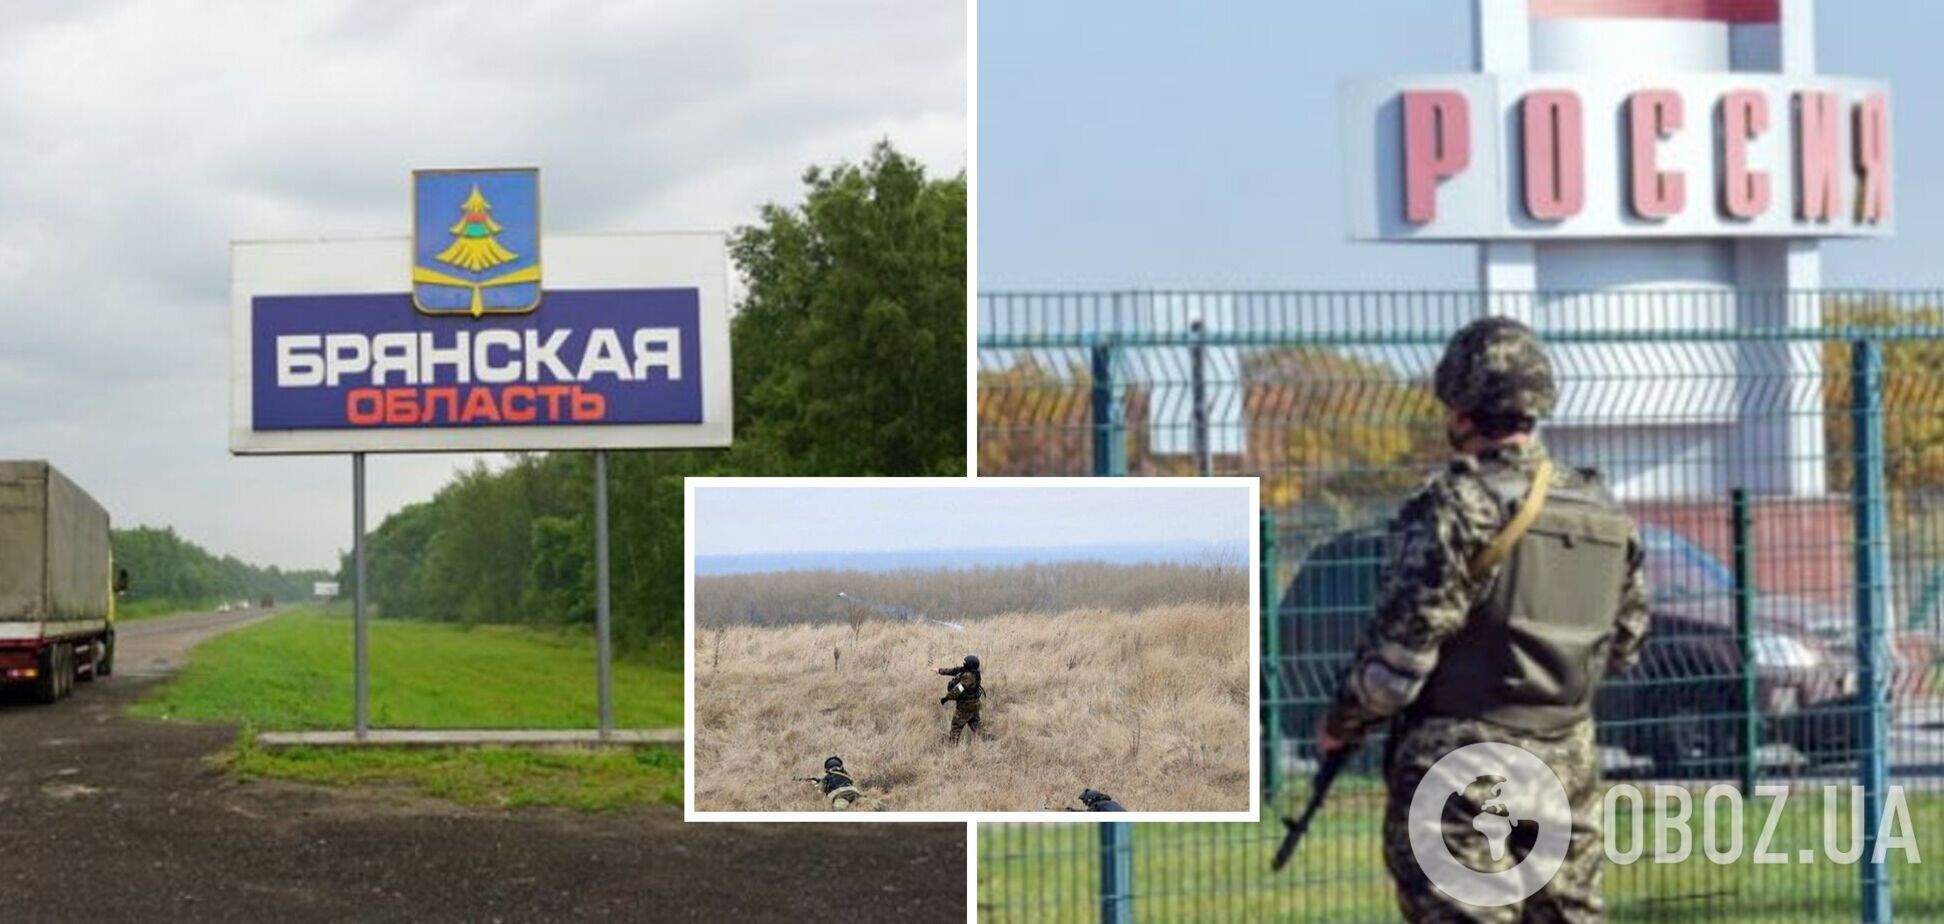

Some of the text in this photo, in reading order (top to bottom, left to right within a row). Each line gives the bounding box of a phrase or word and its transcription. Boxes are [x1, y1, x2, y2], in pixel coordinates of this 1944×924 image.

[1402, 88, 1889, 225] РОССИЯ
[276, 327, 682, 387] БРЯНСКАЯ
[345, 384, 606, 425] ОБЛАСТЬ
